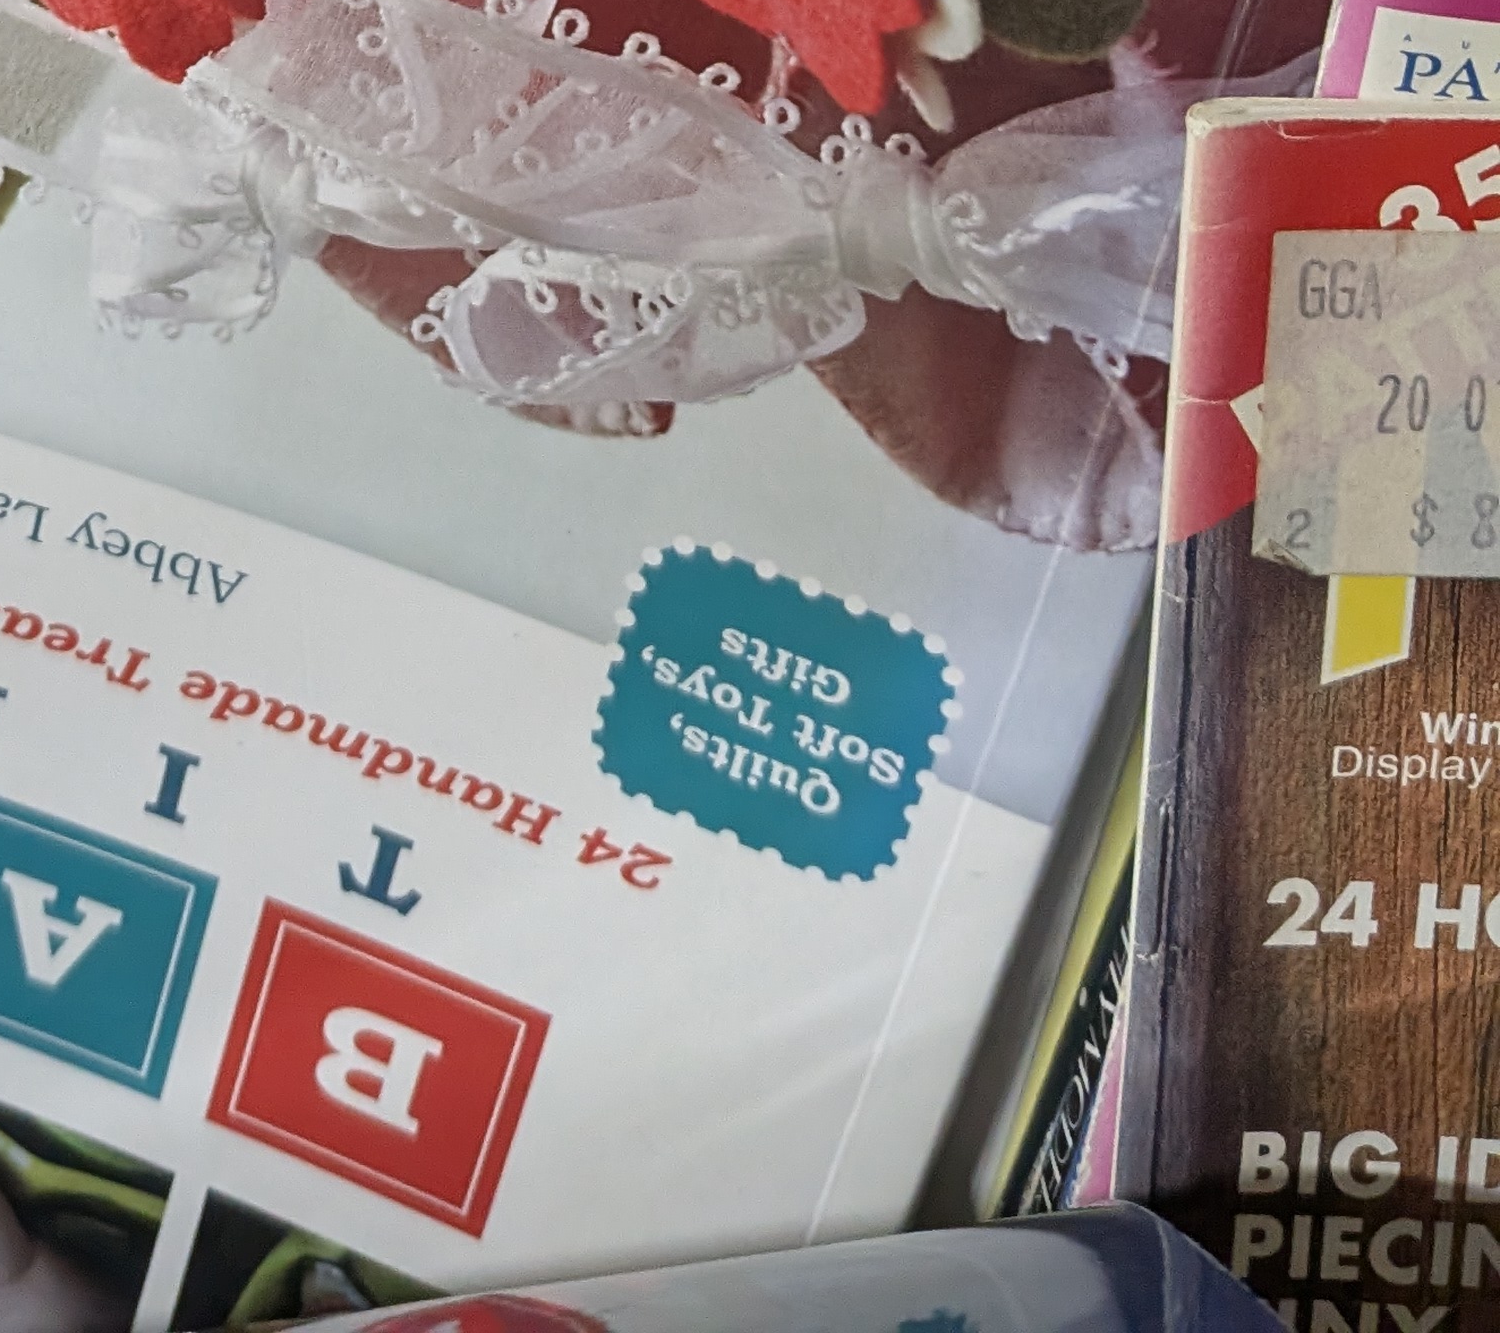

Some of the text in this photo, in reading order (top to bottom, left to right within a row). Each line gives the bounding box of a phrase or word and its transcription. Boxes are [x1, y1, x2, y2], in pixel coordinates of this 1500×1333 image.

[1393, 49, 1500, 102] PA
[66, 512, 250, 605] Abbey
[720, 626, 852, 705] Gifts
[640, 645, 906, 785] Soft Toys,
[178, 668, 562, 847] Handmade
[670, 713, 842, 815] Quilts,
[1331, 745, 1492, 789] Display
[576, 826, 674, 891] 24
[1263, 877, 1379, 948] 24
[1237, 1129, 1400, 1200] BIG
